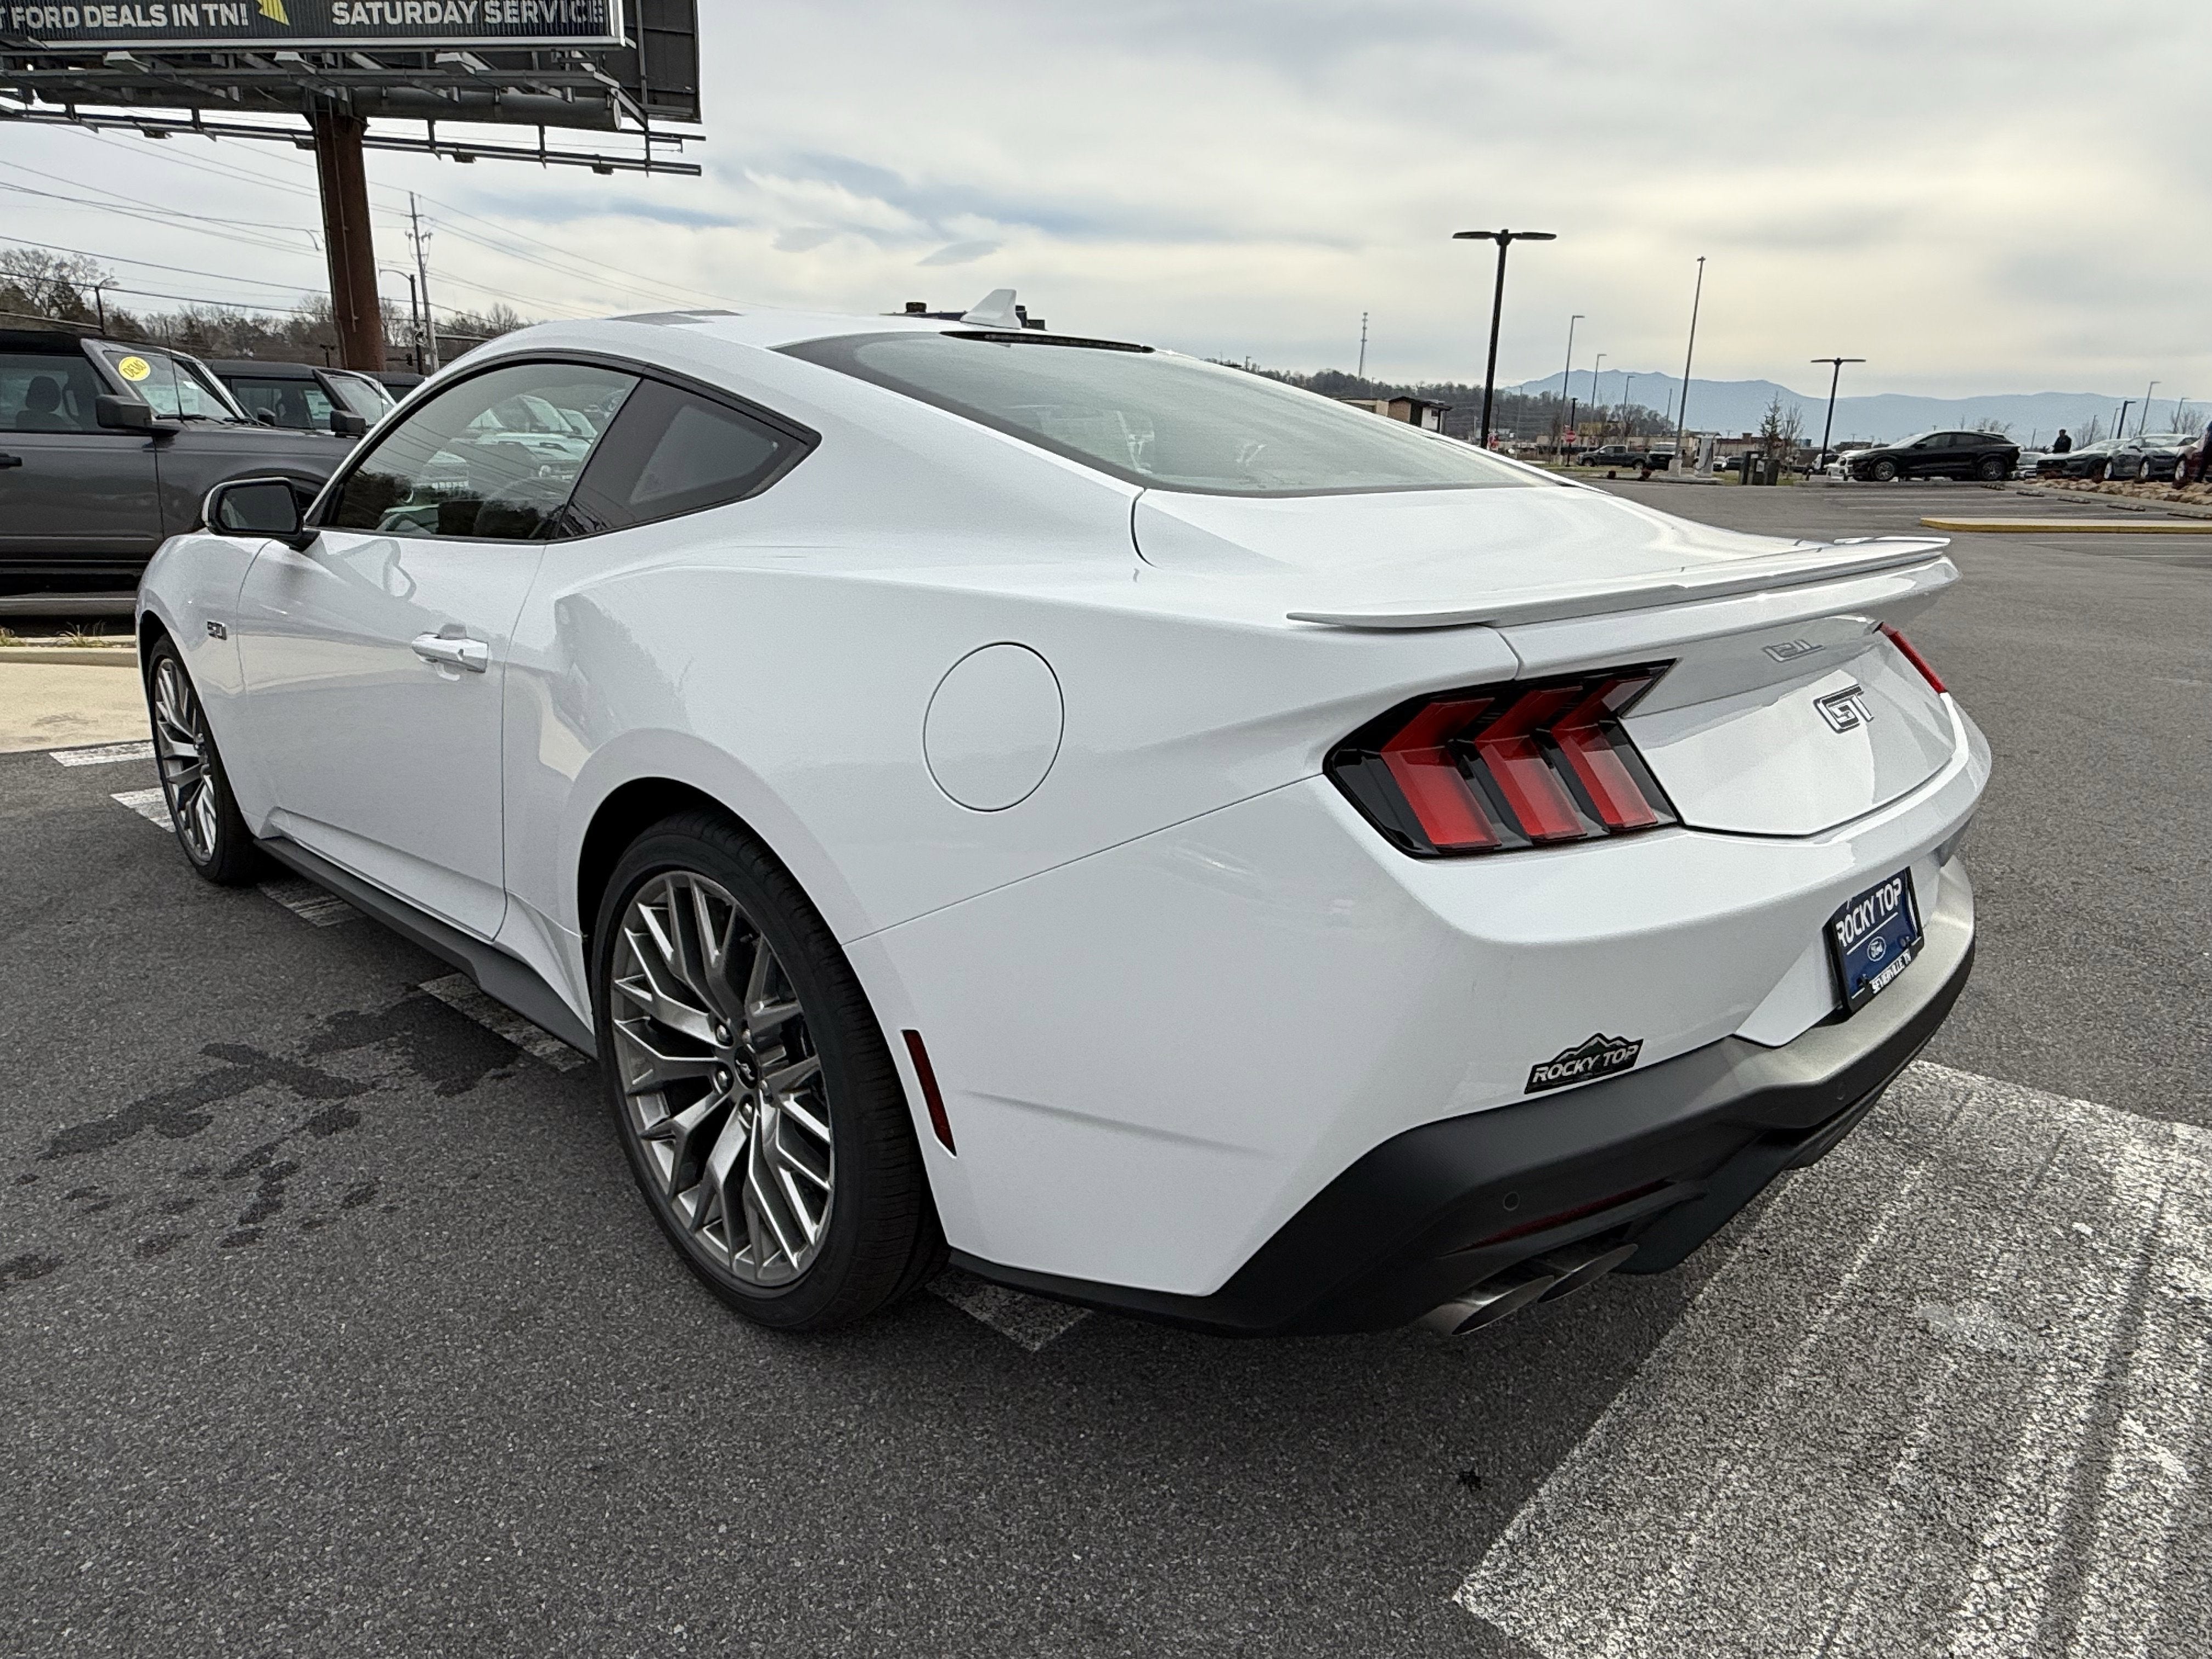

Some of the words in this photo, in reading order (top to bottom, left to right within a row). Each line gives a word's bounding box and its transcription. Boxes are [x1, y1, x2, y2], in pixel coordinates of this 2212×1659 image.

[12, 7, 79, 29] FORD
[84, 5, 168, 28] DEALS
[173, 4, 199, 27] IN
[202, 3, 249, 26] TN!
[332, 1, 477, 25] SATURDAY
[484, 0, 604, 24] SERVICE
[1813, 684, 1875, 734] GT
[1836, 896, 1875, 947] ROCKY
[1876, 878, 1901, 916] TOP
[1533, 1054, 1600, 1083] ROCKY
[1603, 1045, 1639, 1066] TOP
